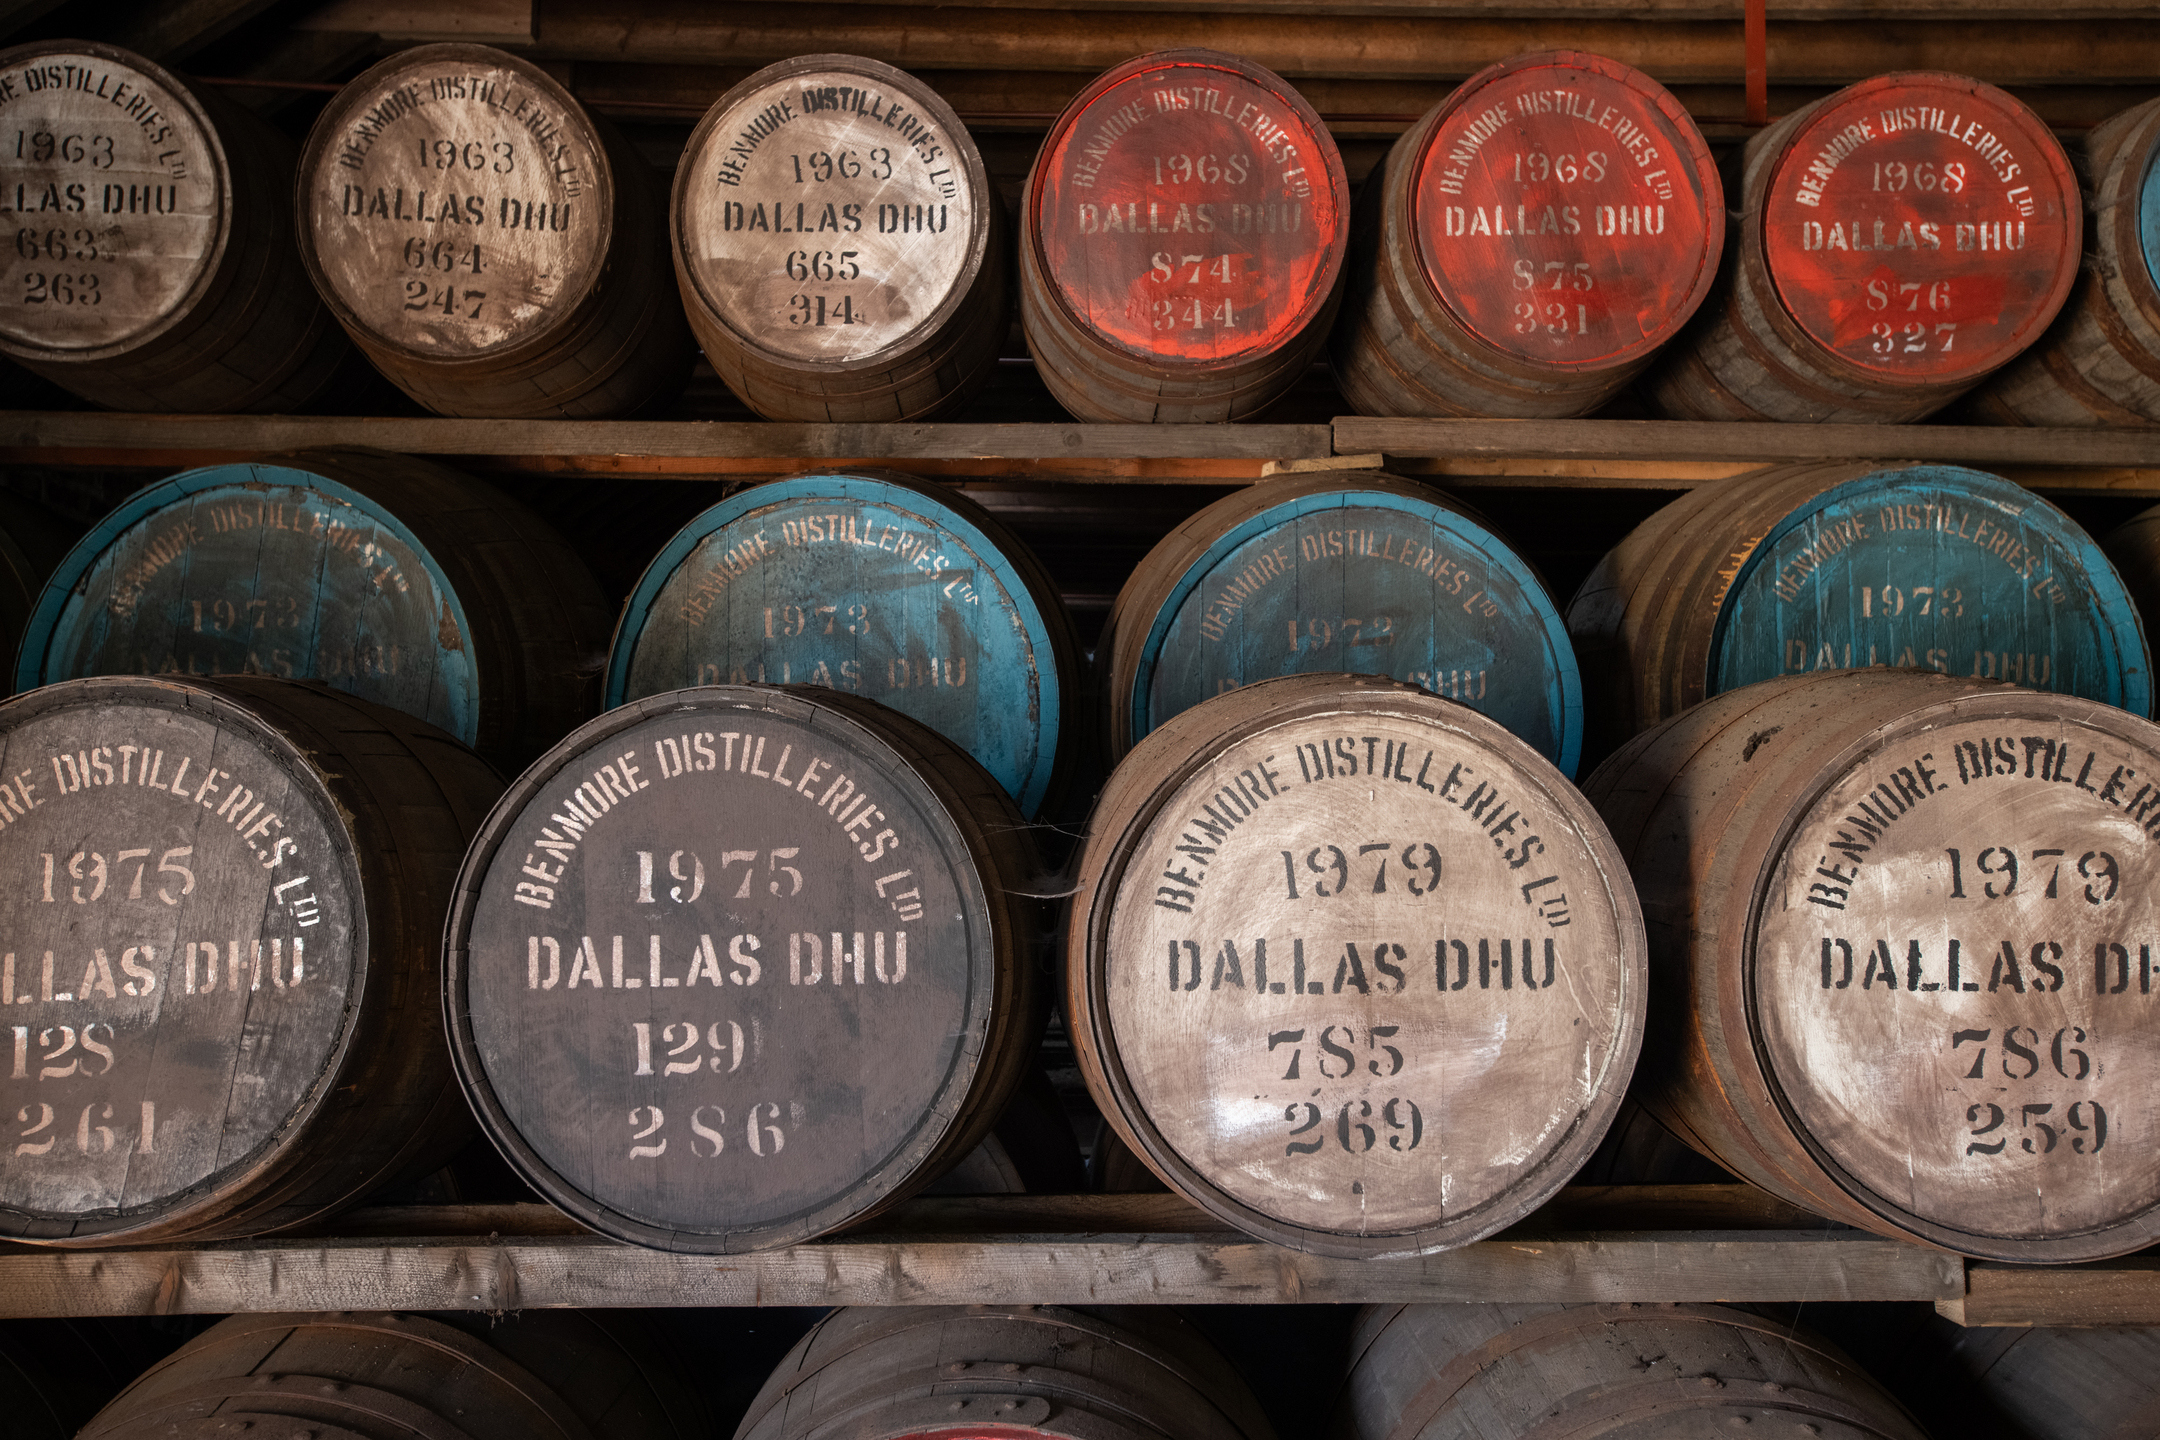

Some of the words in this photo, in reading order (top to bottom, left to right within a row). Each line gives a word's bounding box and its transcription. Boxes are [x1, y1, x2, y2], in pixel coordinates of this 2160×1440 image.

[25, 66, 172, 145] DISTILLERIES
[340, 83, 424, 170] BENMORE
[431, 76, 570, 161] DISTILLERIES
[16, 131, 114, 169] 1963
[419, 139, 514, 174] 1963
[718, 97, 798, 186] BENMORE
[802, 86, 943, 164] DISTILLERIES
[1072, 97, 1150, 188] BENMORE
[1154, 87, 1297, 164] DISTILLERIES
[1440, 102, 1513, 194] BENMORE
[1517, 90, 1658, 168] DISTILLERIES
[1796, 117, 1876, 207] BENMORE
[1880, 106, 2021, 183] DISTILLERIES
[791, 148, 892, 183] 1963
[1153, 154, 1249, 185] 1968
[1514, 151, 1607, 183] 1968
[1873, 162, 1965, 193] 1968
[103, 185, 176, 215] DHU
[343, 185, 485, 226] DALLAS
[500, 198, 570, 232] DHU
[724, 201, 862, 233] DALLAS
[879, 203, 947, 234] DHU
[1079, 202, 1215, 234] DALLAS
[1232, 203, 1301, 234] DHU
[1446, 205, 1580, 236] DALLAS
[1596, 205, 1664, 235] DHU
[16, 228, 98, 261] 663
[404, 237, 487, 274] 664
[1803, 221, 1941, 251] DALLAS
[1956, 221, 2025, 251] DHU
[25, 272, 101, 305] 263
[786, 250, 859, 281] 665
[1151, 252, 1236, 283] 874
[1513, 259, 1593, 291] 875
[404, 281, 486, 319] 247
[790, 294, 859, 326] 314
[1514, 303, 1589, 334] 331
[1867, 279, 1950, 312] 876
[1872, 322, 1957, 353] 327
[678, 530, 775, 626] BENMORE
[782, 514, 949, 580] DISTILLERIES
[1773, 514, 1870, 603] BENMORE
[1880, 504, 2040, 579] DISTILLERIES
[1199, 545, 1295, 642] BENMORE
[1302, 529, 1469, 594] DISTILLERIES
[1861, 585, 1963, 618] 1973
[190, 598, 299, 632] 1973
[763, 604, 870, 639] 1973
[888, 657, 966, 689] DHU
[1975, 651, 2050, 685] DHU
[52, 745, 297, 870] DISTILLERIES
[515, 751, 649, 908] BENMORE
[655, 732, 899, 862] DISTILLERIES
[875, 869, 924, 922] LTD
[1155, 755, 1290, 912] BENMORE
[1296, 737, 1544, 869] DISTILLERIES
[1521, 875, 1571, 927] LTD
[1808, 754, 1949, 910] BENMORE
[41, 846, 195, 905] 1975
[636, 847, 803, 903] 1975
[1280, 842, 1442, 899] 1979
[1945, 846, 2119, 905] 1979
[186, 937, 304, 995] DHU
[528, 934, 761, 990] DALLAS
[790, 932, 907, 986] DHU
[1169, 938, 1407, 994] DALLAS
[1436, 938, 1555, 992] DHU
[1820, 938, 2064, 993] DALLAS
[9, 1023, 114, 1081] 128
[632, 1020, 745, 1077] 129
[1268, 1025, 1403, 1081] 785
[1952, 1025, 2090, 1081] 786
[17, 1101, 156, 1158] 261
[628, 1102, 785, 1160] 286
[1285, 1097, 1423, 1157] 269
[1966, 1101, 2108, 1156] 259
